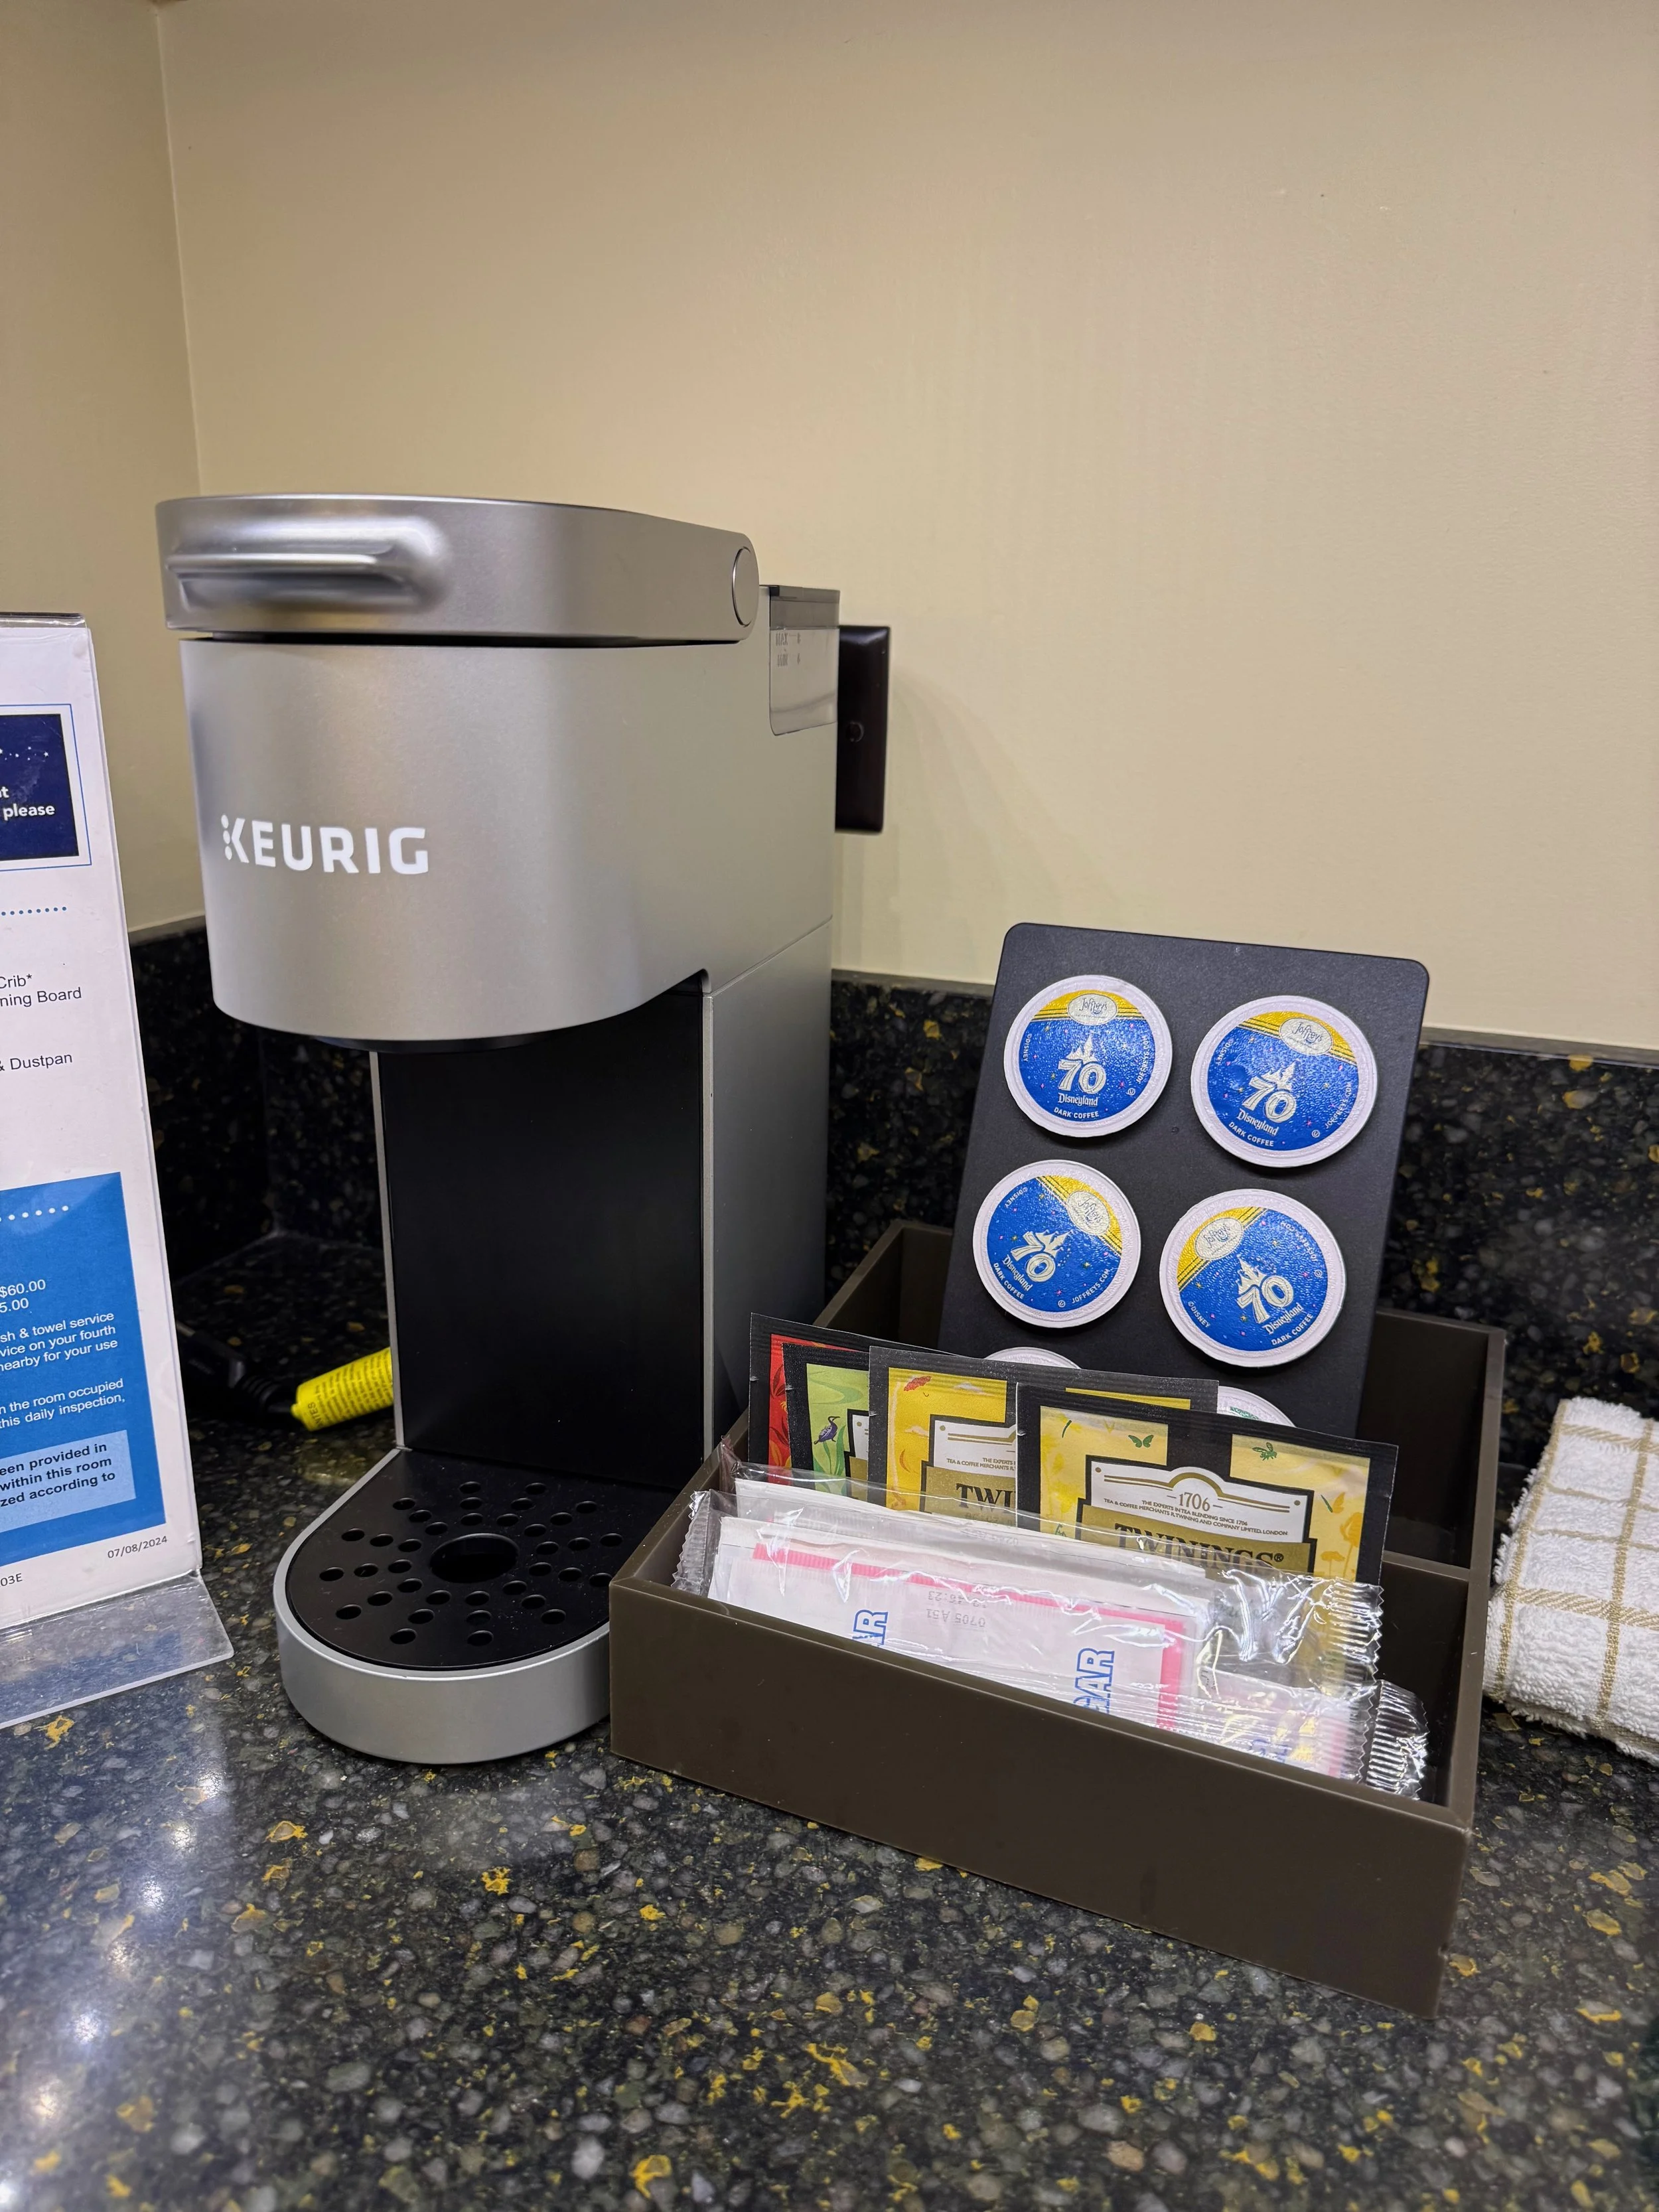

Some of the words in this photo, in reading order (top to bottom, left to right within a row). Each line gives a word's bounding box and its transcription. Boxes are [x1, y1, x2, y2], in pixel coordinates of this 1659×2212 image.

[3, 803, 55, 821] please
[221, 814, 429, 875] KEURIG
[37, 986, 82, 1003] Board
[10, 1053, 72, 1070] Dustpan
[1058, 1058, 1106, 1094] 70
[1054, 1107, 1072, 1118] DARK
[1074, 1110, 1100, 1119] COFFEE
[1057, 1092, 1099, 1107] Disneyland
[1242, 1075, 1297, 1123] 70
[1228, 1121, 1245, 1138] DARK
[1247, 1133, 1275, 1147] COFFEE
[1236, 1108, 1279, 1136] Disneyland
[1010, 1230, 1056, 1282] 70
[993, 1262, 1005, 1281] DARK
[1005, 1280, 1025, 1299] COFFEE
[1001, 1254, 1033, 1292] Disneyland
[1071, 1268, 1110, 1305] JOFFREYS.COM
[0, 1279, 46, 1299] $60.00
[1236, 1275, 1294, 1325] 70
[19, 1328, 29, 1339] &
[33, 1320, 66, 1336] towel
[70, 1313, 115, 1328] service
[1187, 1301, 1211, 1328] ©DISNEY
[1262, 1302, 1304, 1335] Disneyland
[29, 1341, 45, 1351] on
[48, 1334, 77, 1349] your
[80, 1325, 116, 1341] fourth
[1271, 1333, 1291, 1346] DARK
[1292, 1313, 1314, 1335] COFFEE
[43, 1351, 61, 1362] for
[64, 1345, 92, 1360] your
[96, 1339, 118, 1351] use
[9, 1400, 30, 1412] the
[33, 1392, 65, 1406] room
[68, 1378, 124, 1398] occupied
[0, 1416, 21, 1428] this
[25, 1408, 54, 1423] daily
[59, 1394, 125, 1415] inspection,
[29, 1445, 90, 1471] provided
[94, 1443, 107, 1453] in
[0, 1474, 42, 1491] within
[46, 1467, 72, 1480] this
[76, 1458, 111, 1473] room
[0, 1492, 25, 1507] zed
[29, 1477, 98, 1500] according
[102, 1471, 115, 1482] to
[1179, 1491, 1210, 1512] 1706
[1139, 1505, 1170, 1516] MERCHANTS
[1213, 1522, 1240, 1531] COMPANY
[1153, 1502, 1174, 1511] EXPERTS
[1192, 1511, 1218, 1520] BLENDING
[108, 1535, 167, 1558] 07/08/2024
